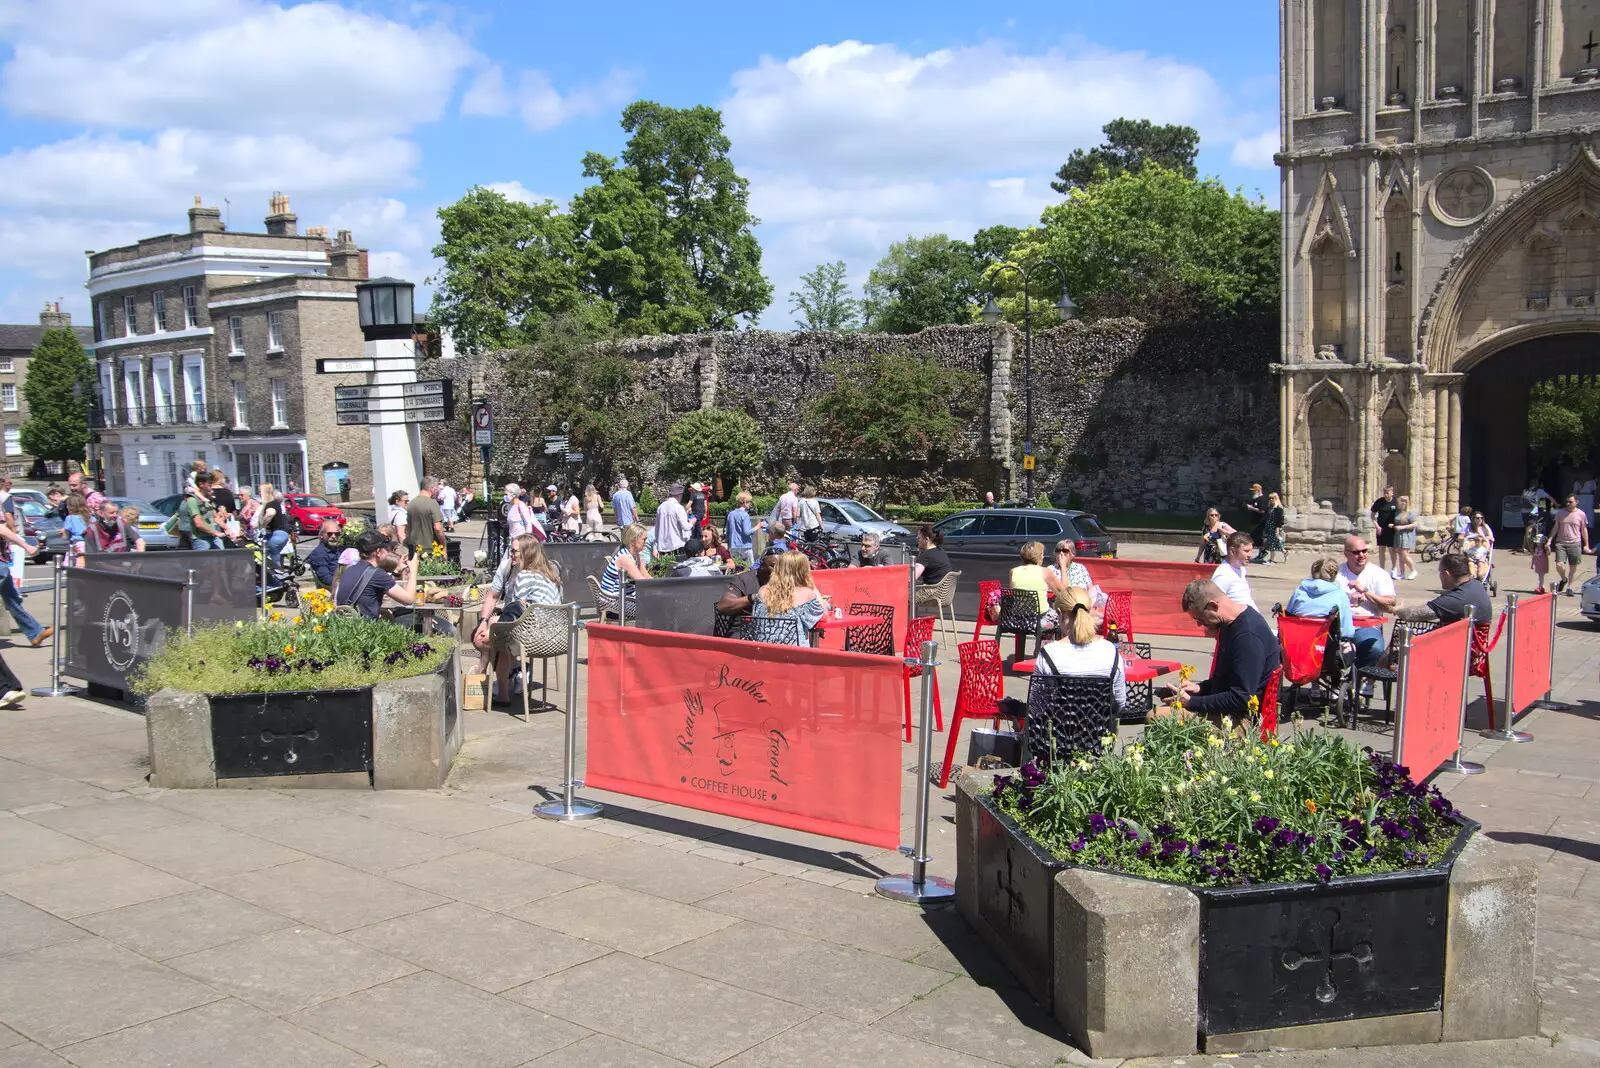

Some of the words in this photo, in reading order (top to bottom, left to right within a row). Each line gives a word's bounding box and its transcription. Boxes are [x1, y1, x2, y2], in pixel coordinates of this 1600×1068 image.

[423, 383, 442, 392] IPSWICH
[416, 396, 443, 406] STOWMARKET
[423, 409, 443, 418] SUDBURY
[675, 688, 704, 768] Really
[704, 664, 772, 706] Rather
[760, 717, 790, 787] Good
[690, 776, 729, 794] COFFEE
[731, 784, 768, 801] HOUSE
